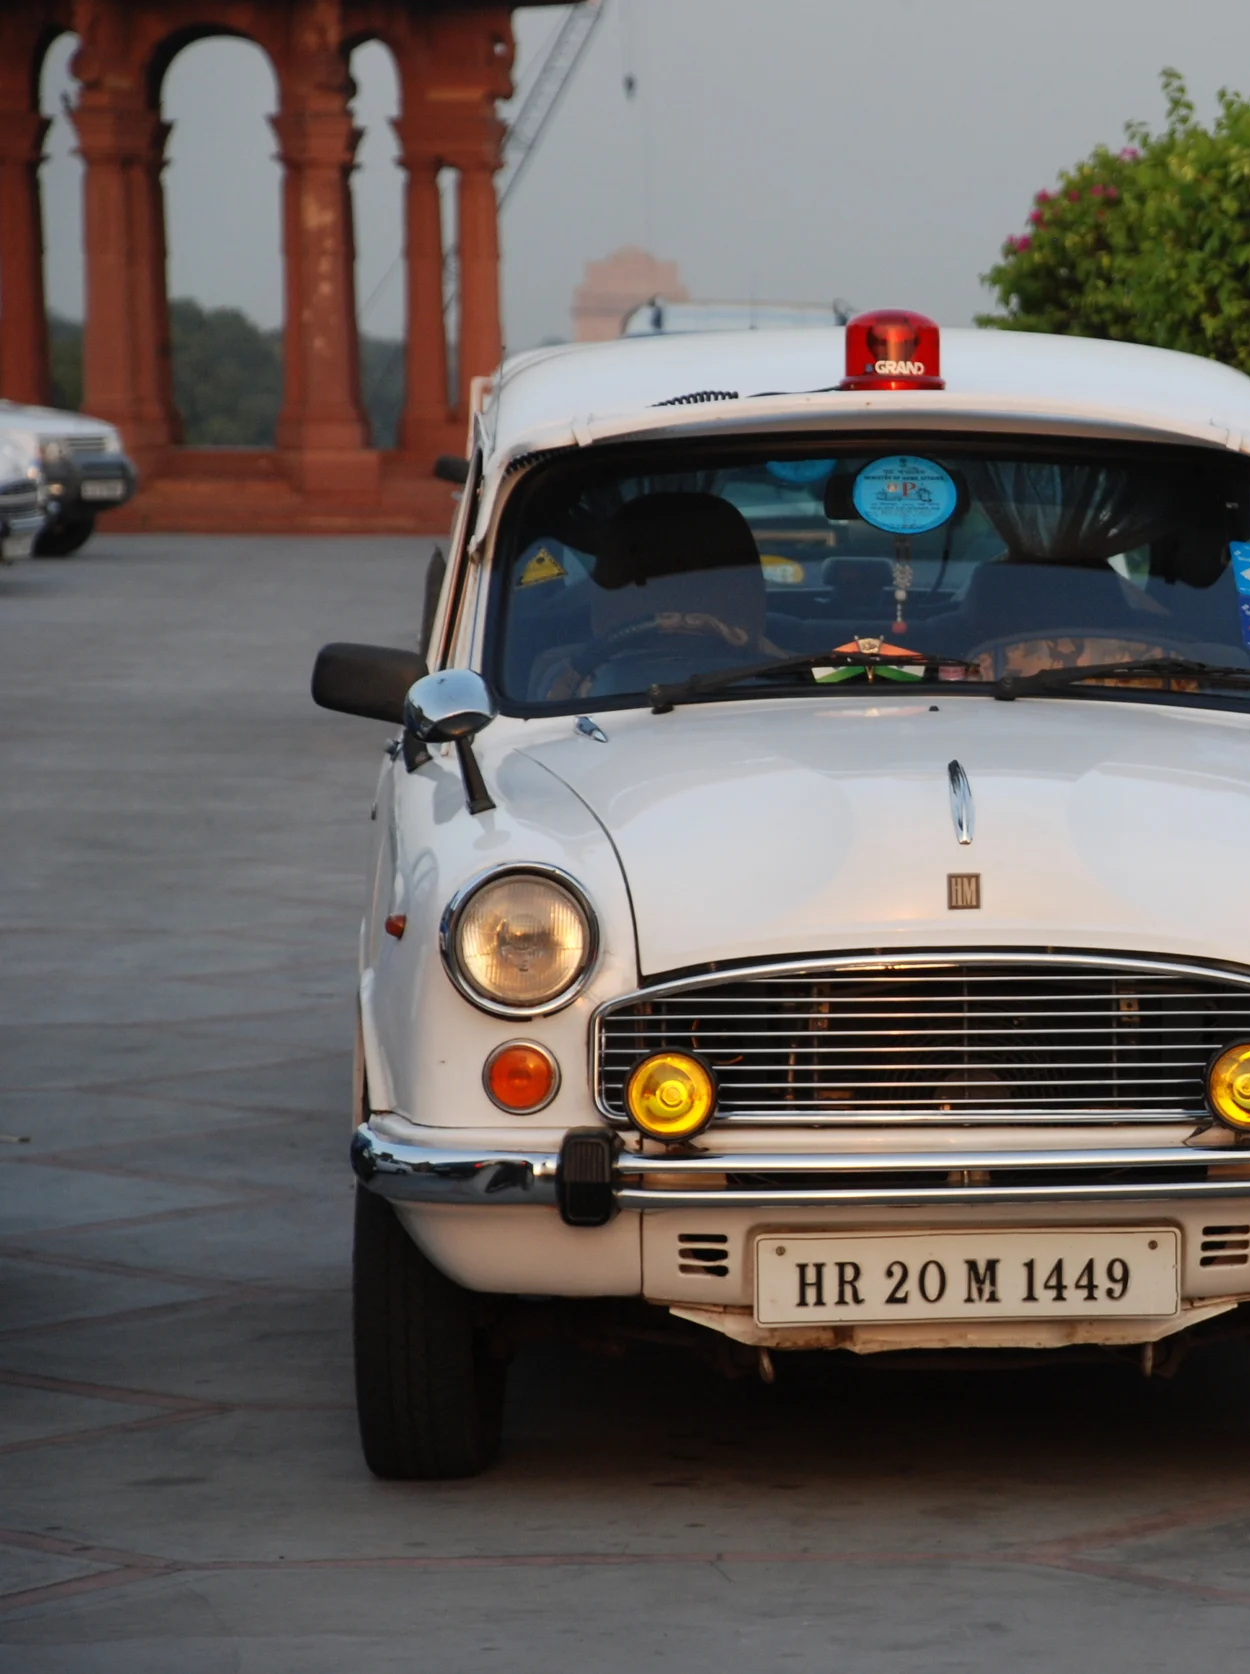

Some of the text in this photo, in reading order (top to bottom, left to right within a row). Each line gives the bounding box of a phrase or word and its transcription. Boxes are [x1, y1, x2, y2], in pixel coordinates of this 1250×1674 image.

[875, 360, 925, 375] GRAND
[902, 481, 917, 497] P
[951, 877, 977, 906] HM
[795, 1258, 1131, 1308] HR 20 M 1449
